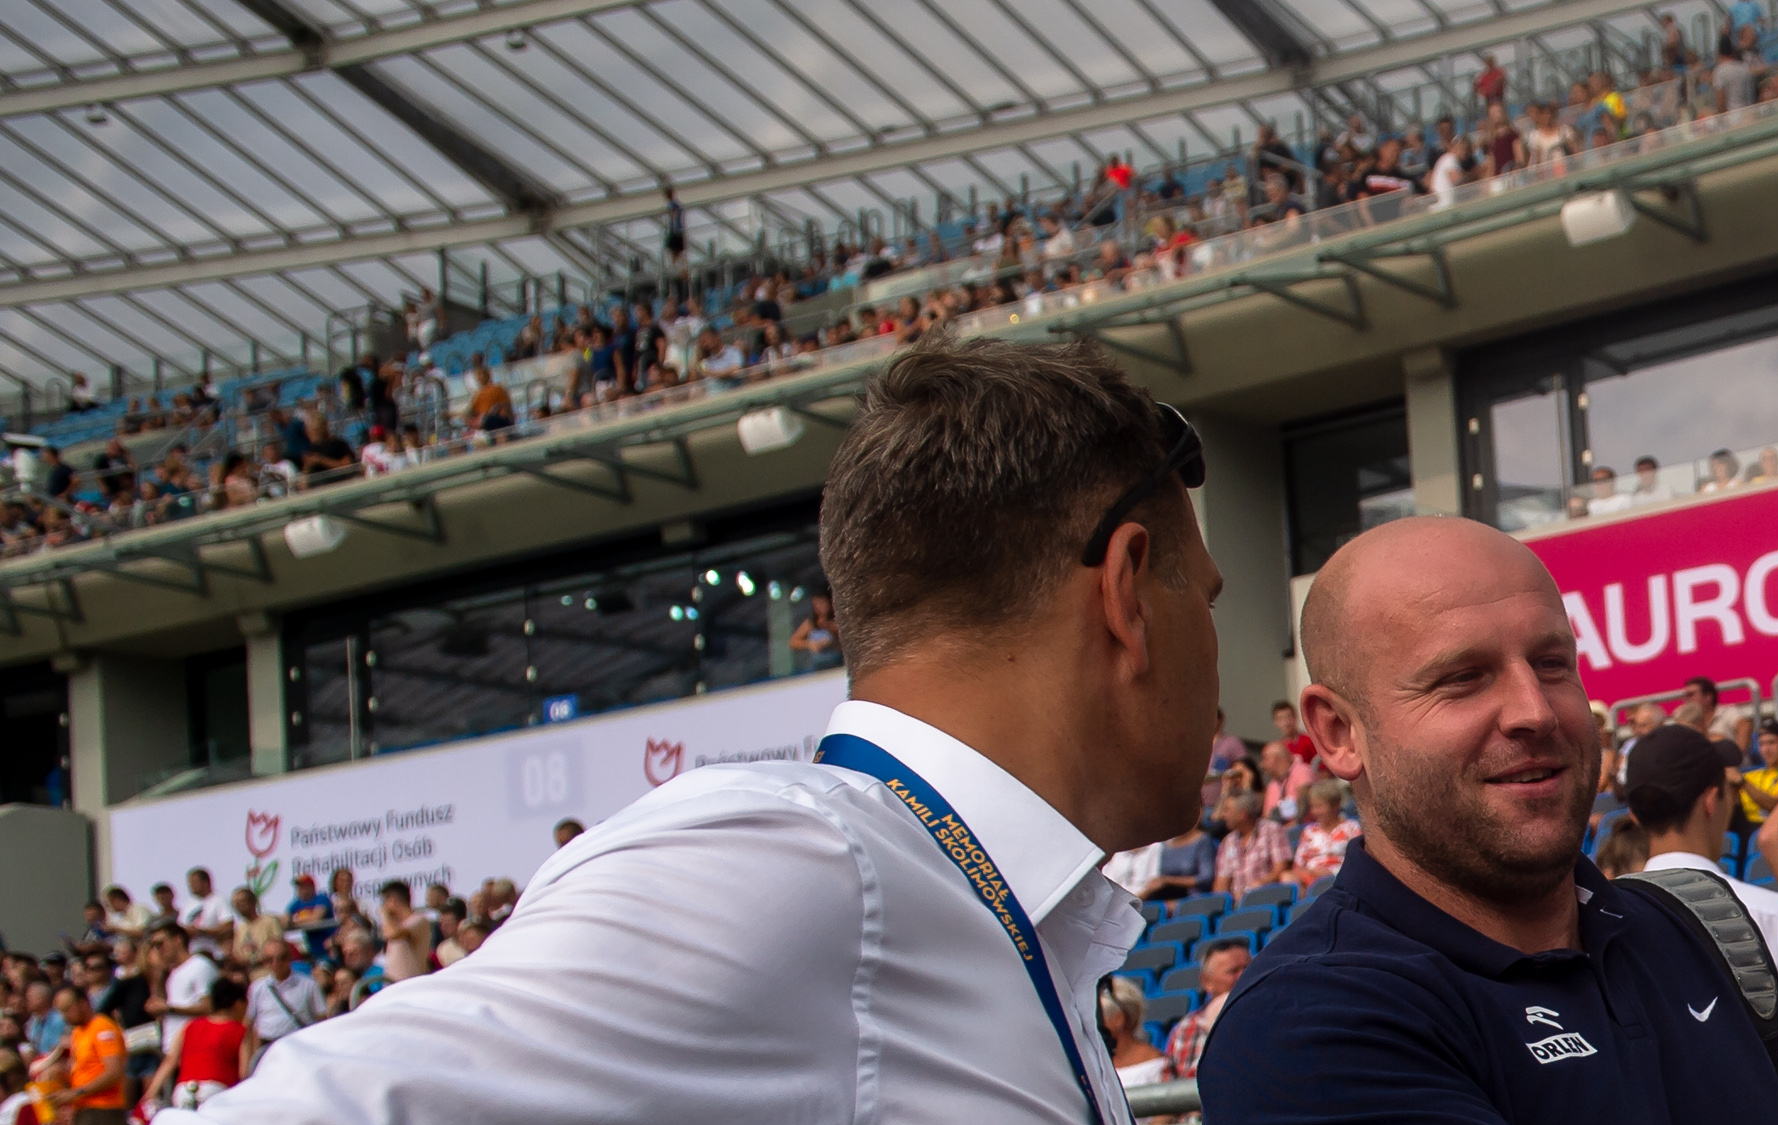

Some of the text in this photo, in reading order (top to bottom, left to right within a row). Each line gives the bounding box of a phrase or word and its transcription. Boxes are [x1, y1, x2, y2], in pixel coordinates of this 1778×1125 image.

[522, 751, 567, 808] 08
[290, 804, 454, 848] Państwowy Fundusz
[291, 833, 432, 878] Rehabilitacji Osób
[886, 778, 1033, 962] KAMILI SKOLIMOWSKIEJ
[941, 813, 1010, 901] MEMORIAŁ
[1531, 1036, 1590, 1060] ORLEN
